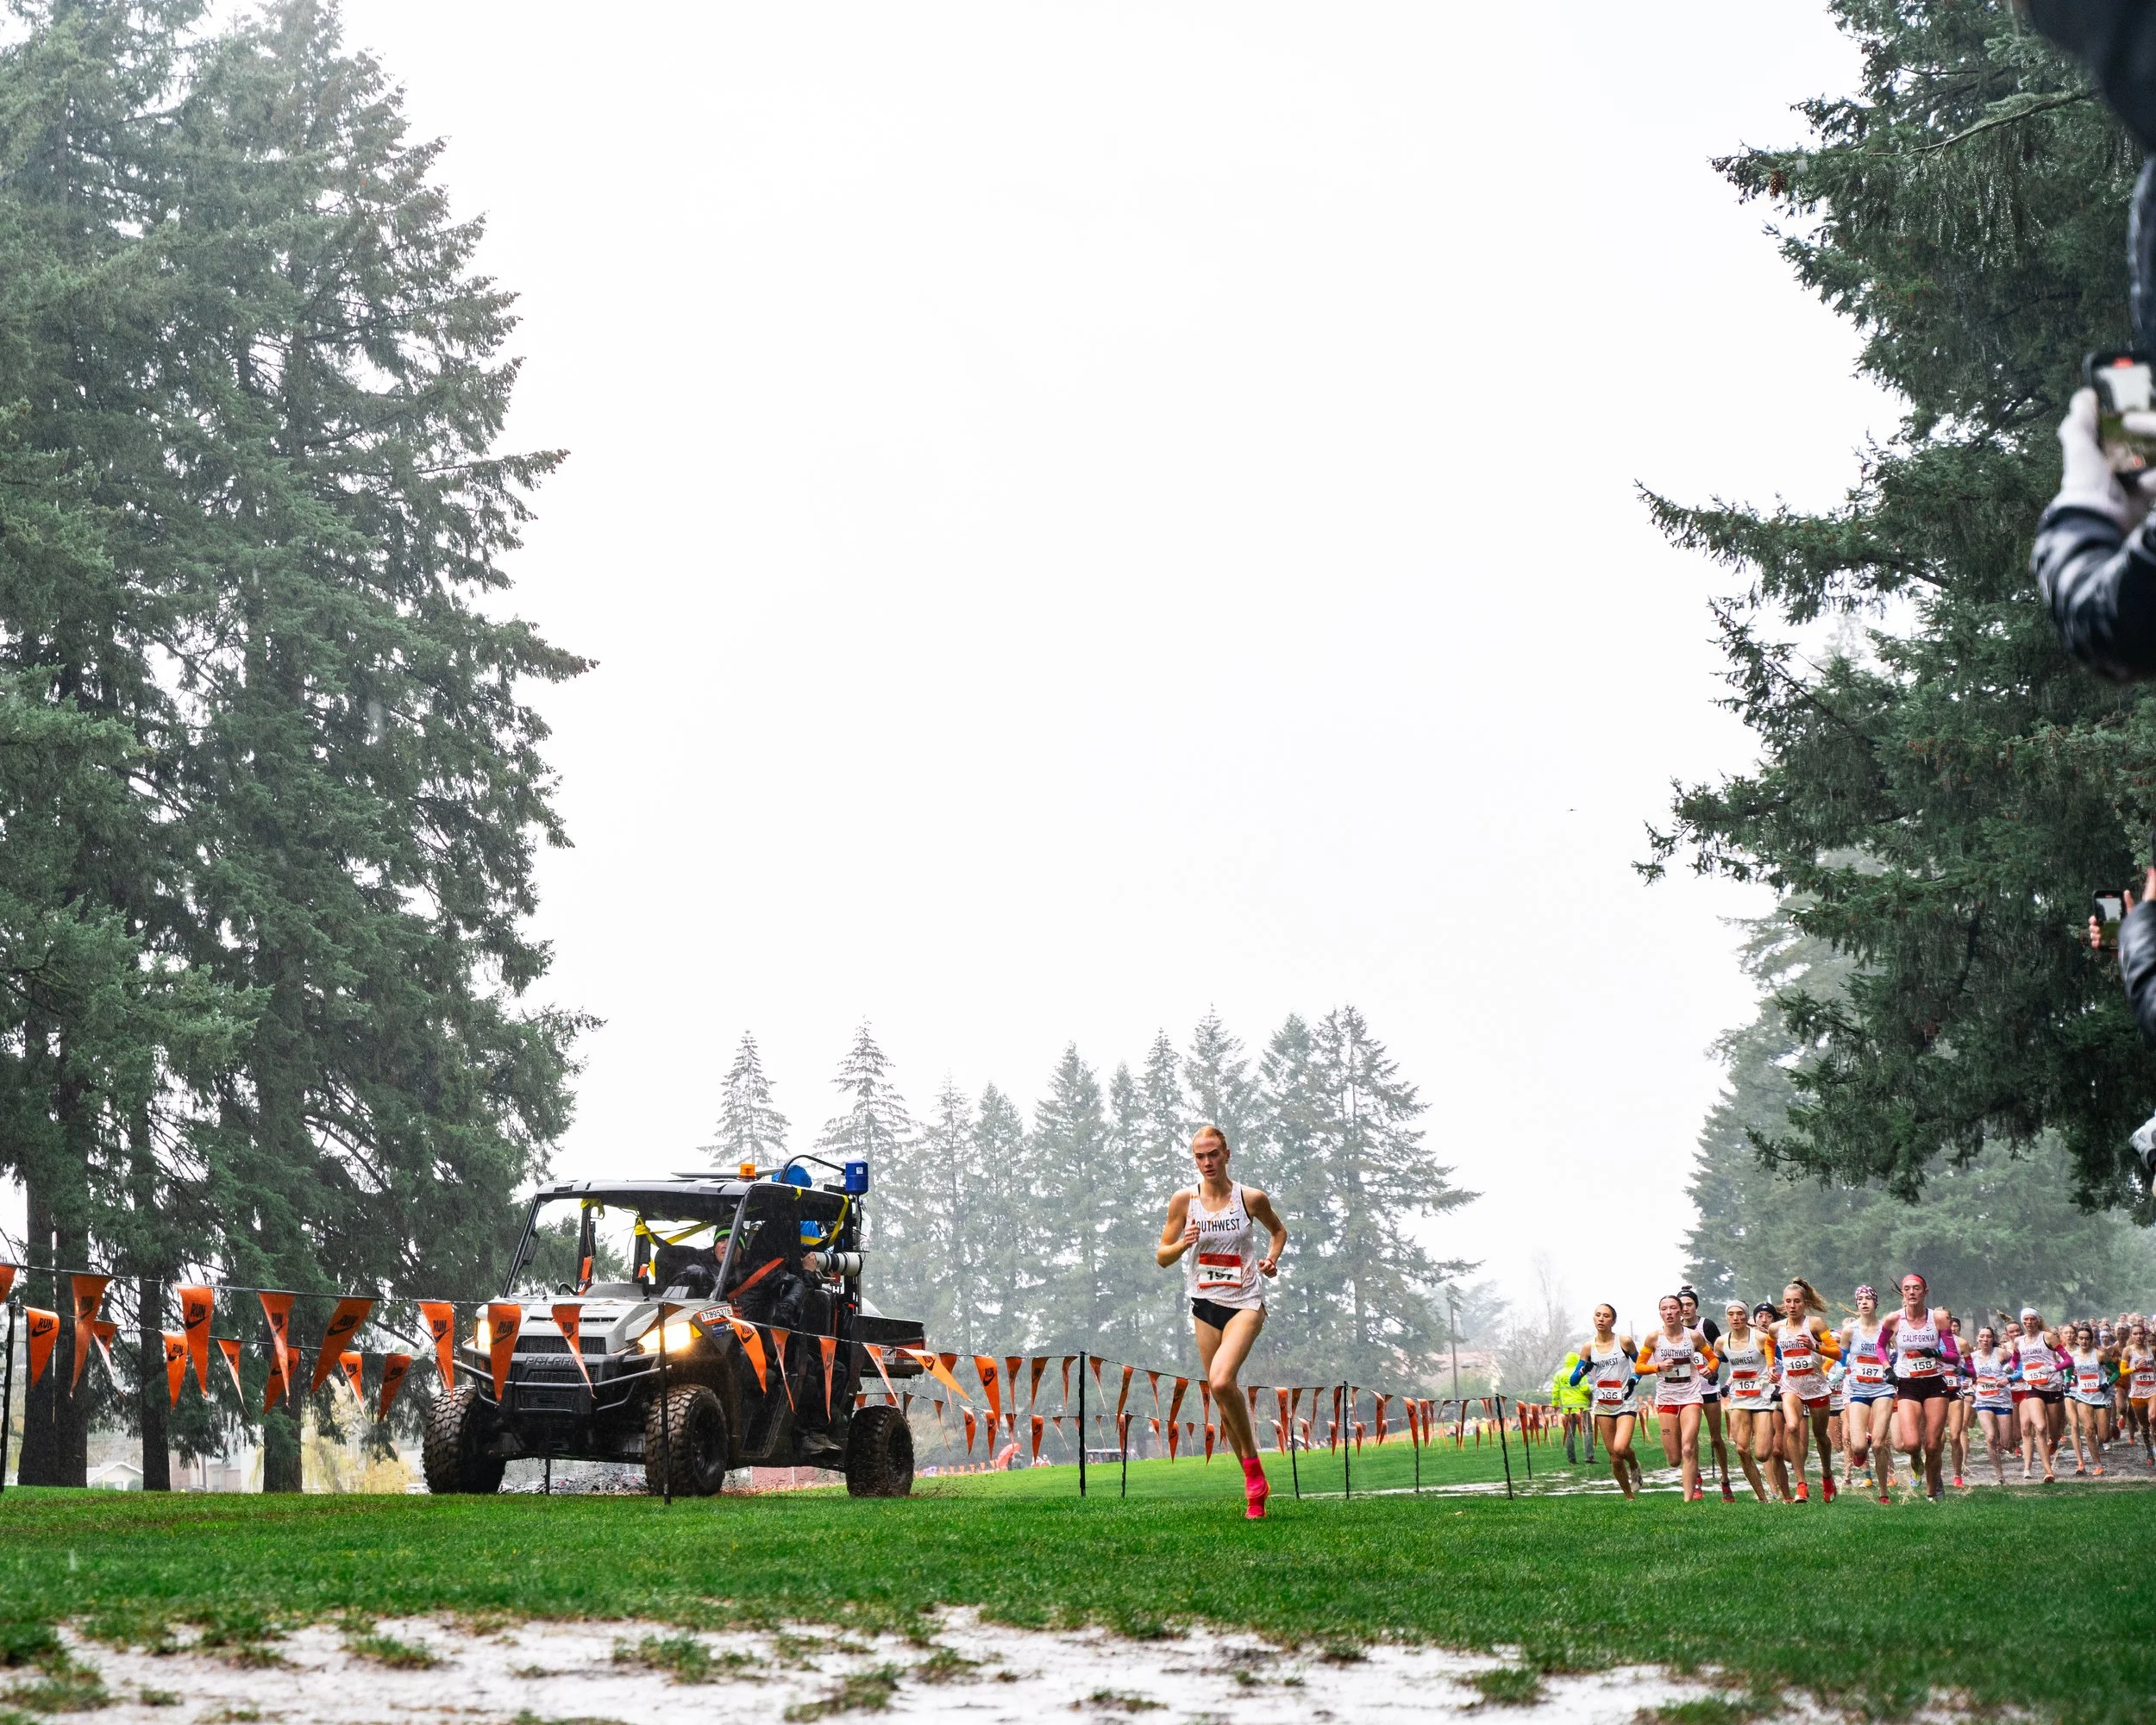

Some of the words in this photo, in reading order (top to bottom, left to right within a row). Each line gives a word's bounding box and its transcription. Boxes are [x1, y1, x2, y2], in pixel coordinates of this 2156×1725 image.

[1195, 1218, 1240, 1233] OUTHWEST
[190, 1302, 207, 1319] RUN
[37, 1317, 54, 1329] RUN
[433, 1320, 447, 1333] RUN
[497, 1320, 515, 1335] RUN
[562, 1321, 574, 1333] RUN
[1902, 1334, 1935, 1343] CALIFORNIA
[172, 1343, 184, 1354] RUN
[1660, 1348, 1692, 1358] SOUTHWEST
[525, 1357, 584, 1366] POLARI
[1729, 1356, 1754, 1366] MIDWEST
[1790, 1360, 1808, 1370] 199
[1913, 1360, 1933, 1371] 158
[1675, 1368, 1680, 1377] 1
[1862, 1368, 1879, 1377] 187
[1739, 1381, 1756, 1389] 167
